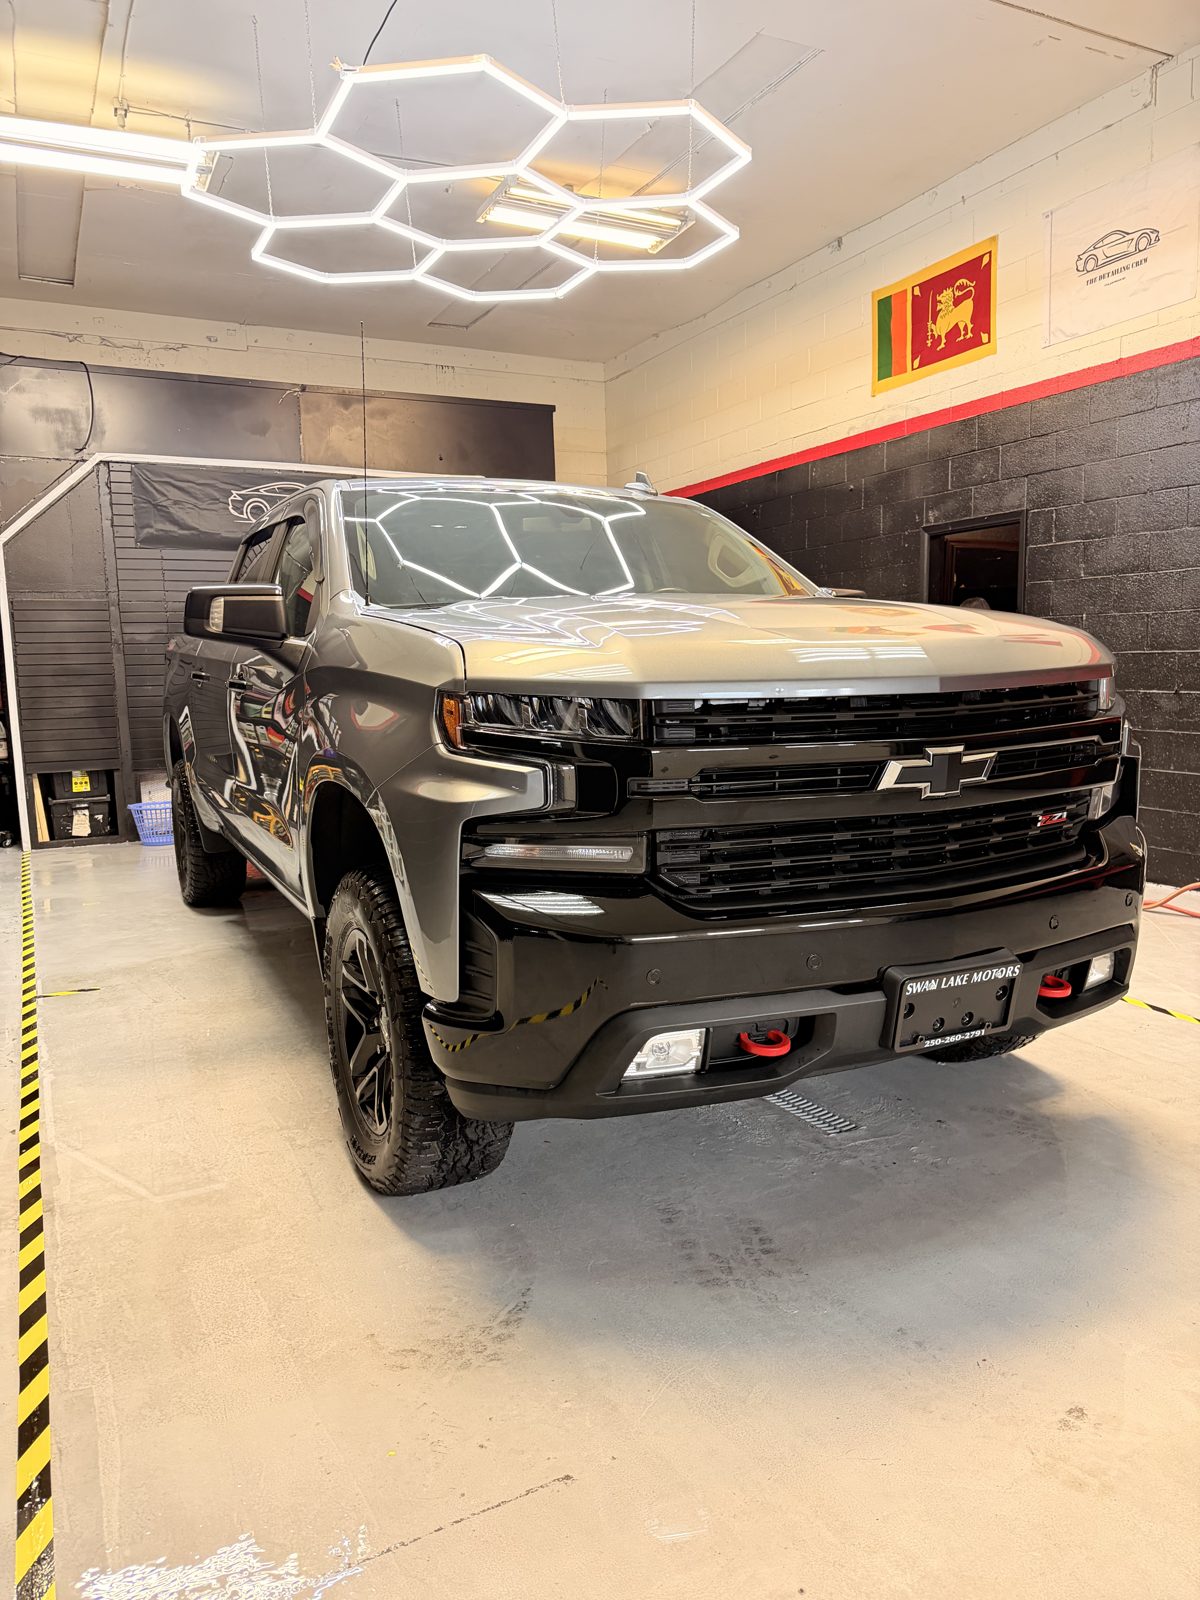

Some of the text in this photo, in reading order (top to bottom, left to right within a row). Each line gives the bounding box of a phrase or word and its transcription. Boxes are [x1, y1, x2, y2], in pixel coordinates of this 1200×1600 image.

[1086, 276, 1098, 286] THE
[1098, 263, 1131, 281] DETAILING
[1131, 257, 1148, 269] CREW
[905, 965, 1020, 995] SWAN LAKE MOTORS
[924, 1028, 985, 1048] 250-260-2791
